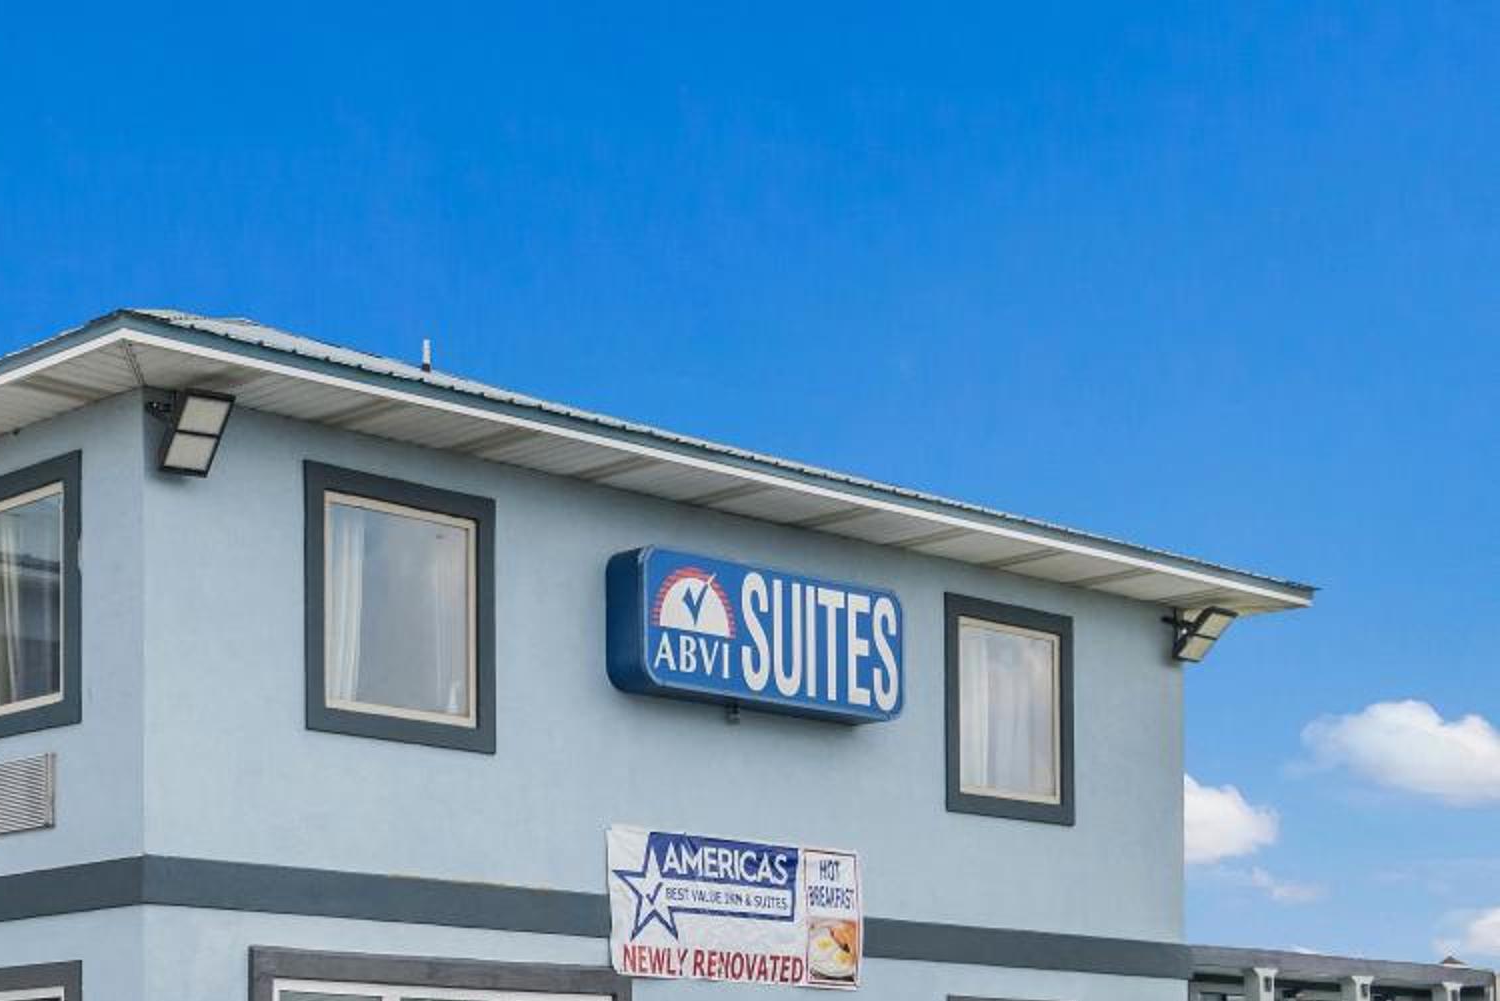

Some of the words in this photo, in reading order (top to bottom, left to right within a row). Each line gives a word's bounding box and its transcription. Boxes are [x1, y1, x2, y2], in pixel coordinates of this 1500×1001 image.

[653, 631, 730, 679] ABVI
[741, 571, 899, 712] SUITES
[661, 840, 788, 885] AMERICAS
[819, 859, 840, 881] HOT
[665, 887, 689, 901] BEST
[692, 889, 721, 904] VALUE
[725, 892, 743, 906] INN
[754, 895, 789, 911] SUITES
[808, 885, 854, 910] BREAKFAST
[622, 943, 688, 977] NEWLY
[692, 949, 805, 984] RENOVATED
